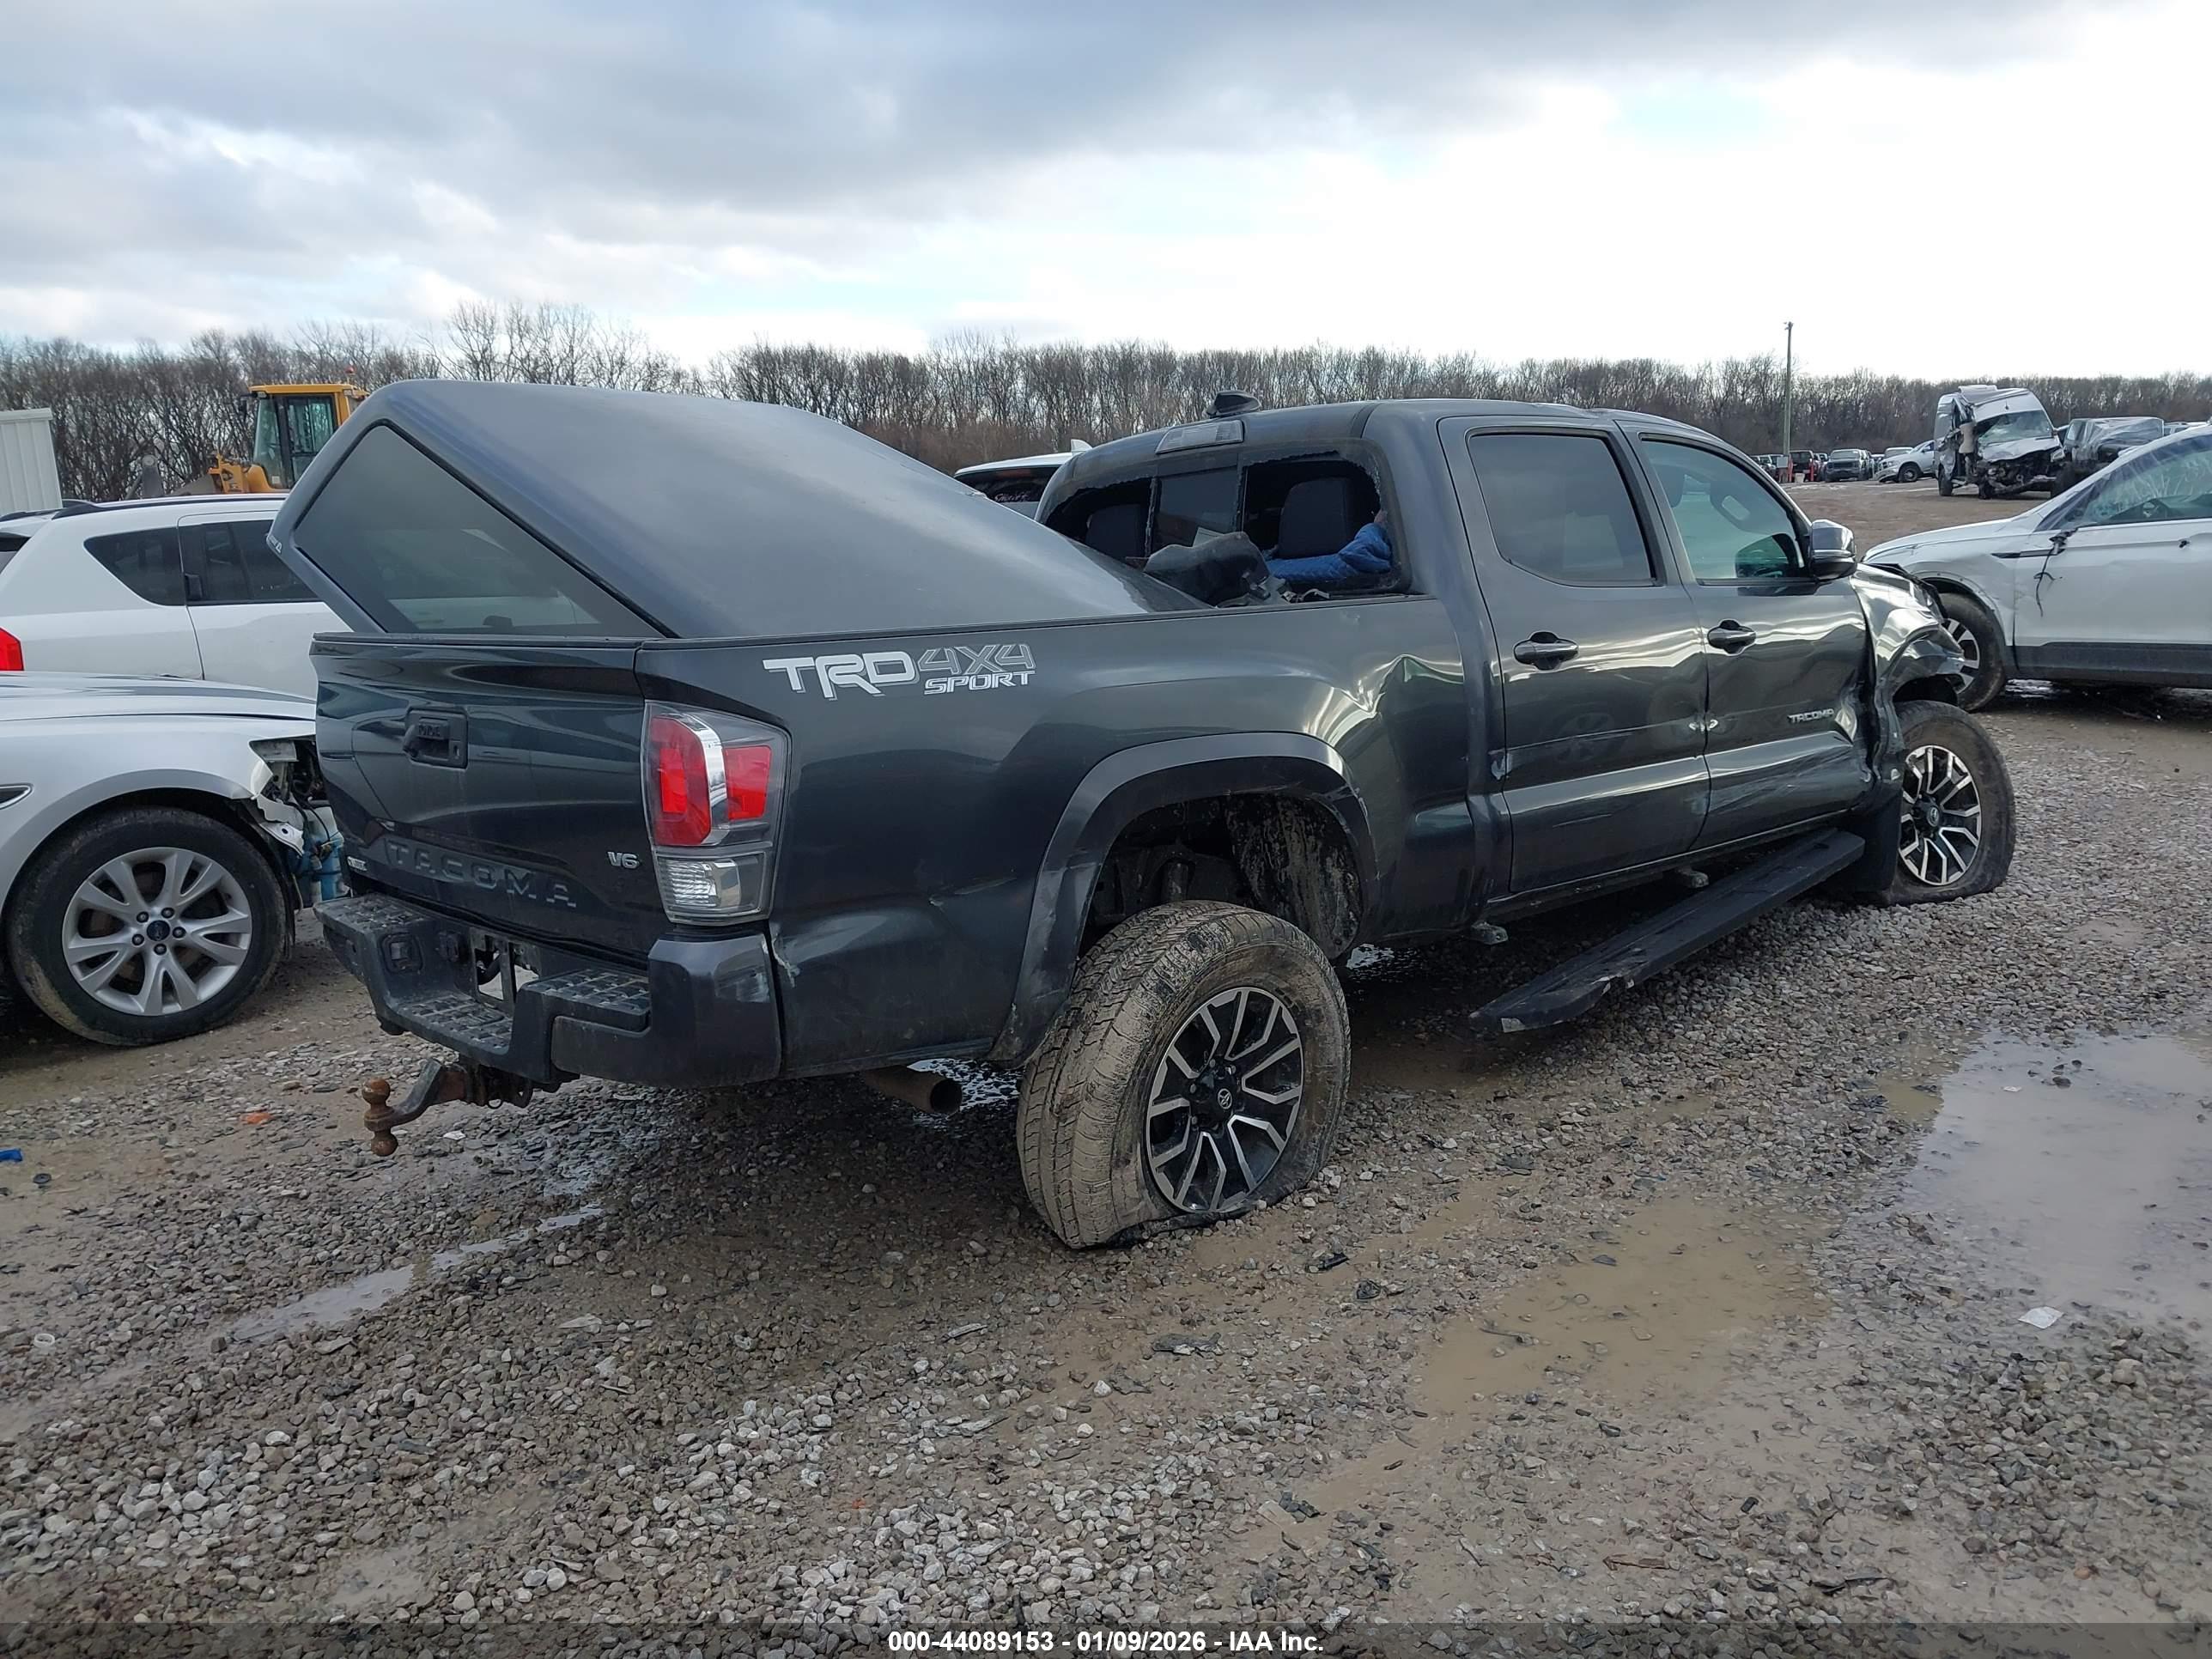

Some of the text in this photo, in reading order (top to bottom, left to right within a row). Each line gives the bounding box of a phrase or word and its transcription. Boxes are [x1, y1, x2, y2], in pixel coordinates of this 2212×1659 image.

[763, 644, 1036, 701] TRD 4X4
[924, 671, 1036, 696] SPORT
[1788, 708, 1835, 724] TACOMA
[607, 851, 639, 869] V6
[386, 840, 577, 908] TACOMA
